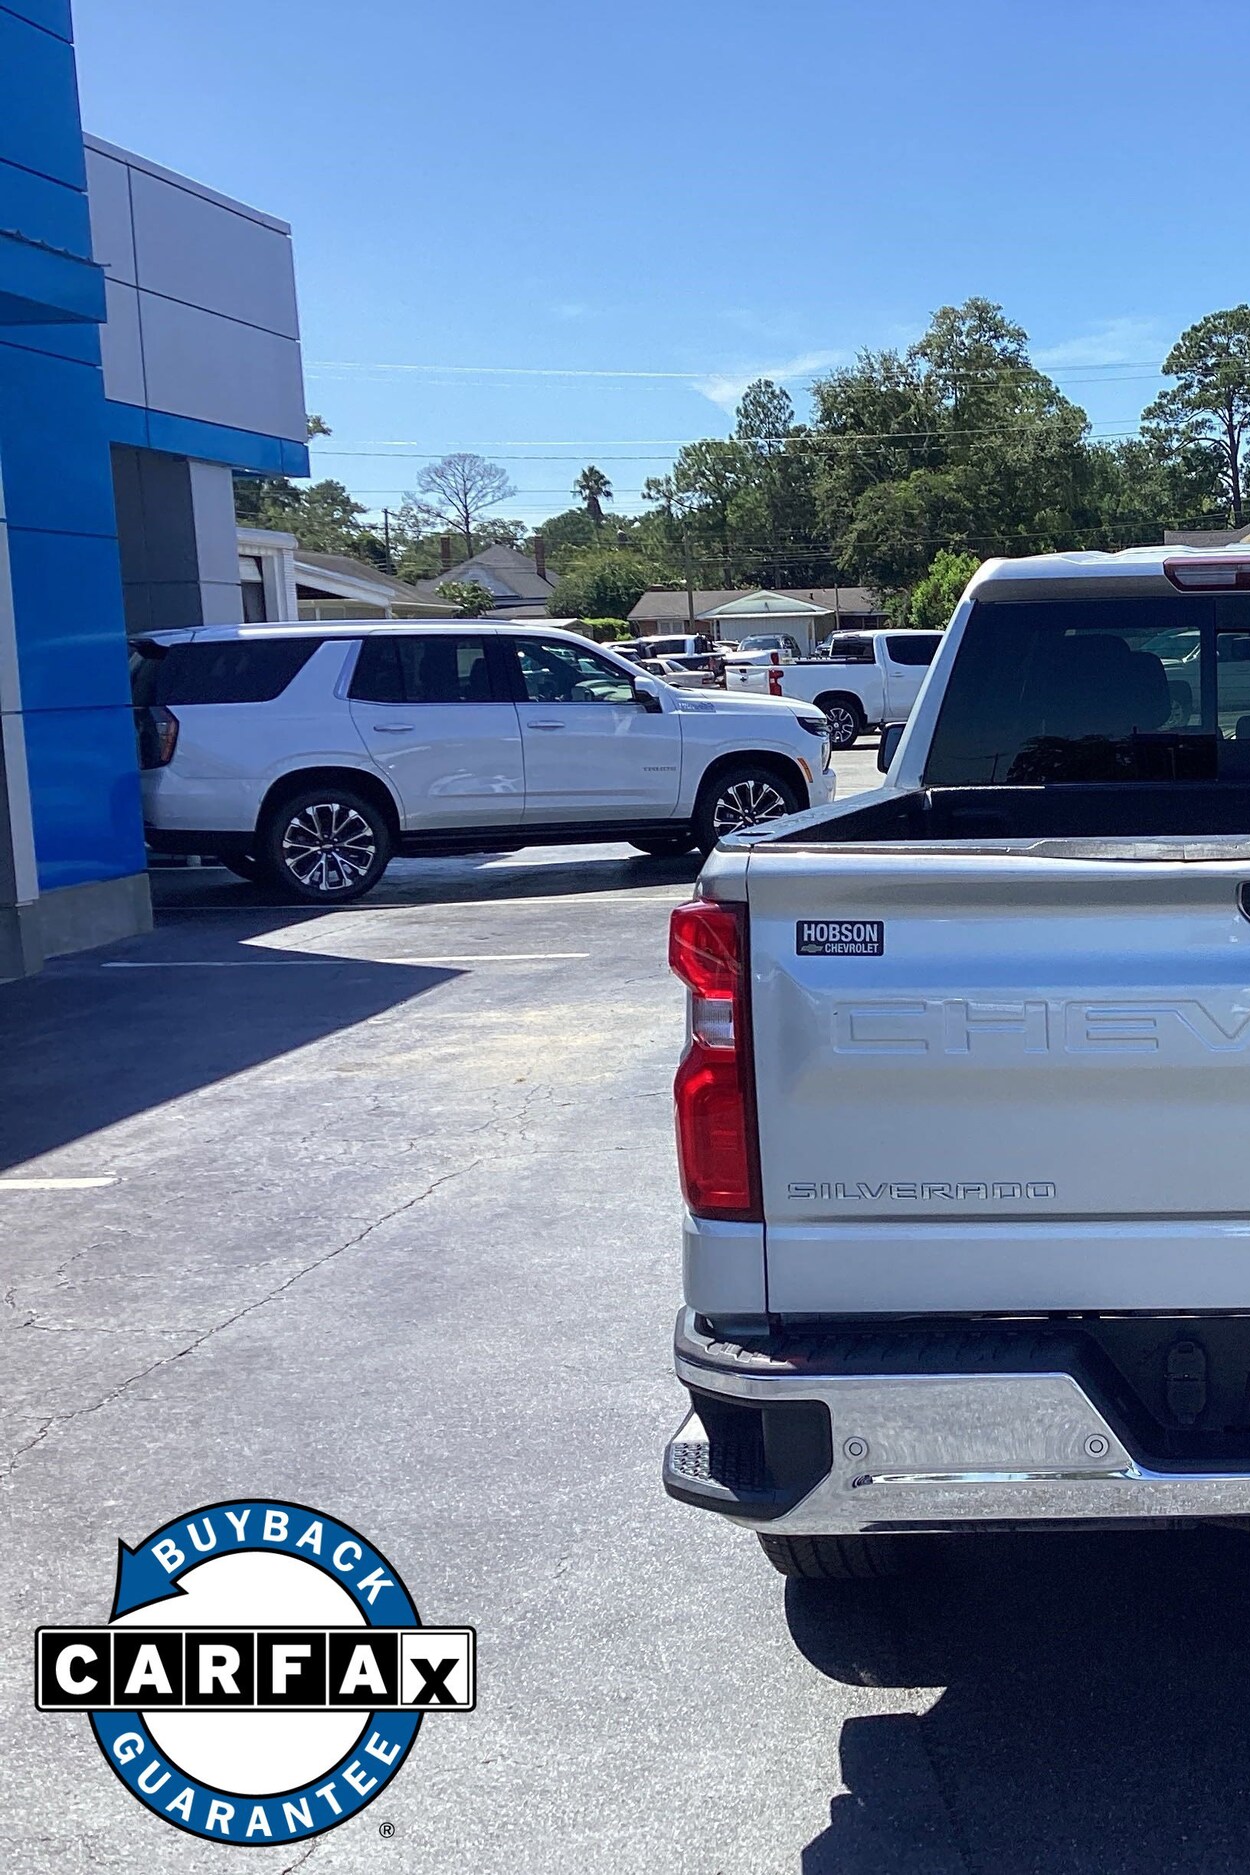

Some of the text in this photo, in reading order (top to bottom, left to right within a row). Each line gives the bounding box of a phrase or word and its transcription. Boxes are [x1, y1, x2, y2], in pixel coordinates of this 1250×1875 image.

[803, 923, 878, 942] HOBSON
[824, 943, 879, 953] CHEVROLET
[788, 1182, 1057, 1200] SILVERADO
